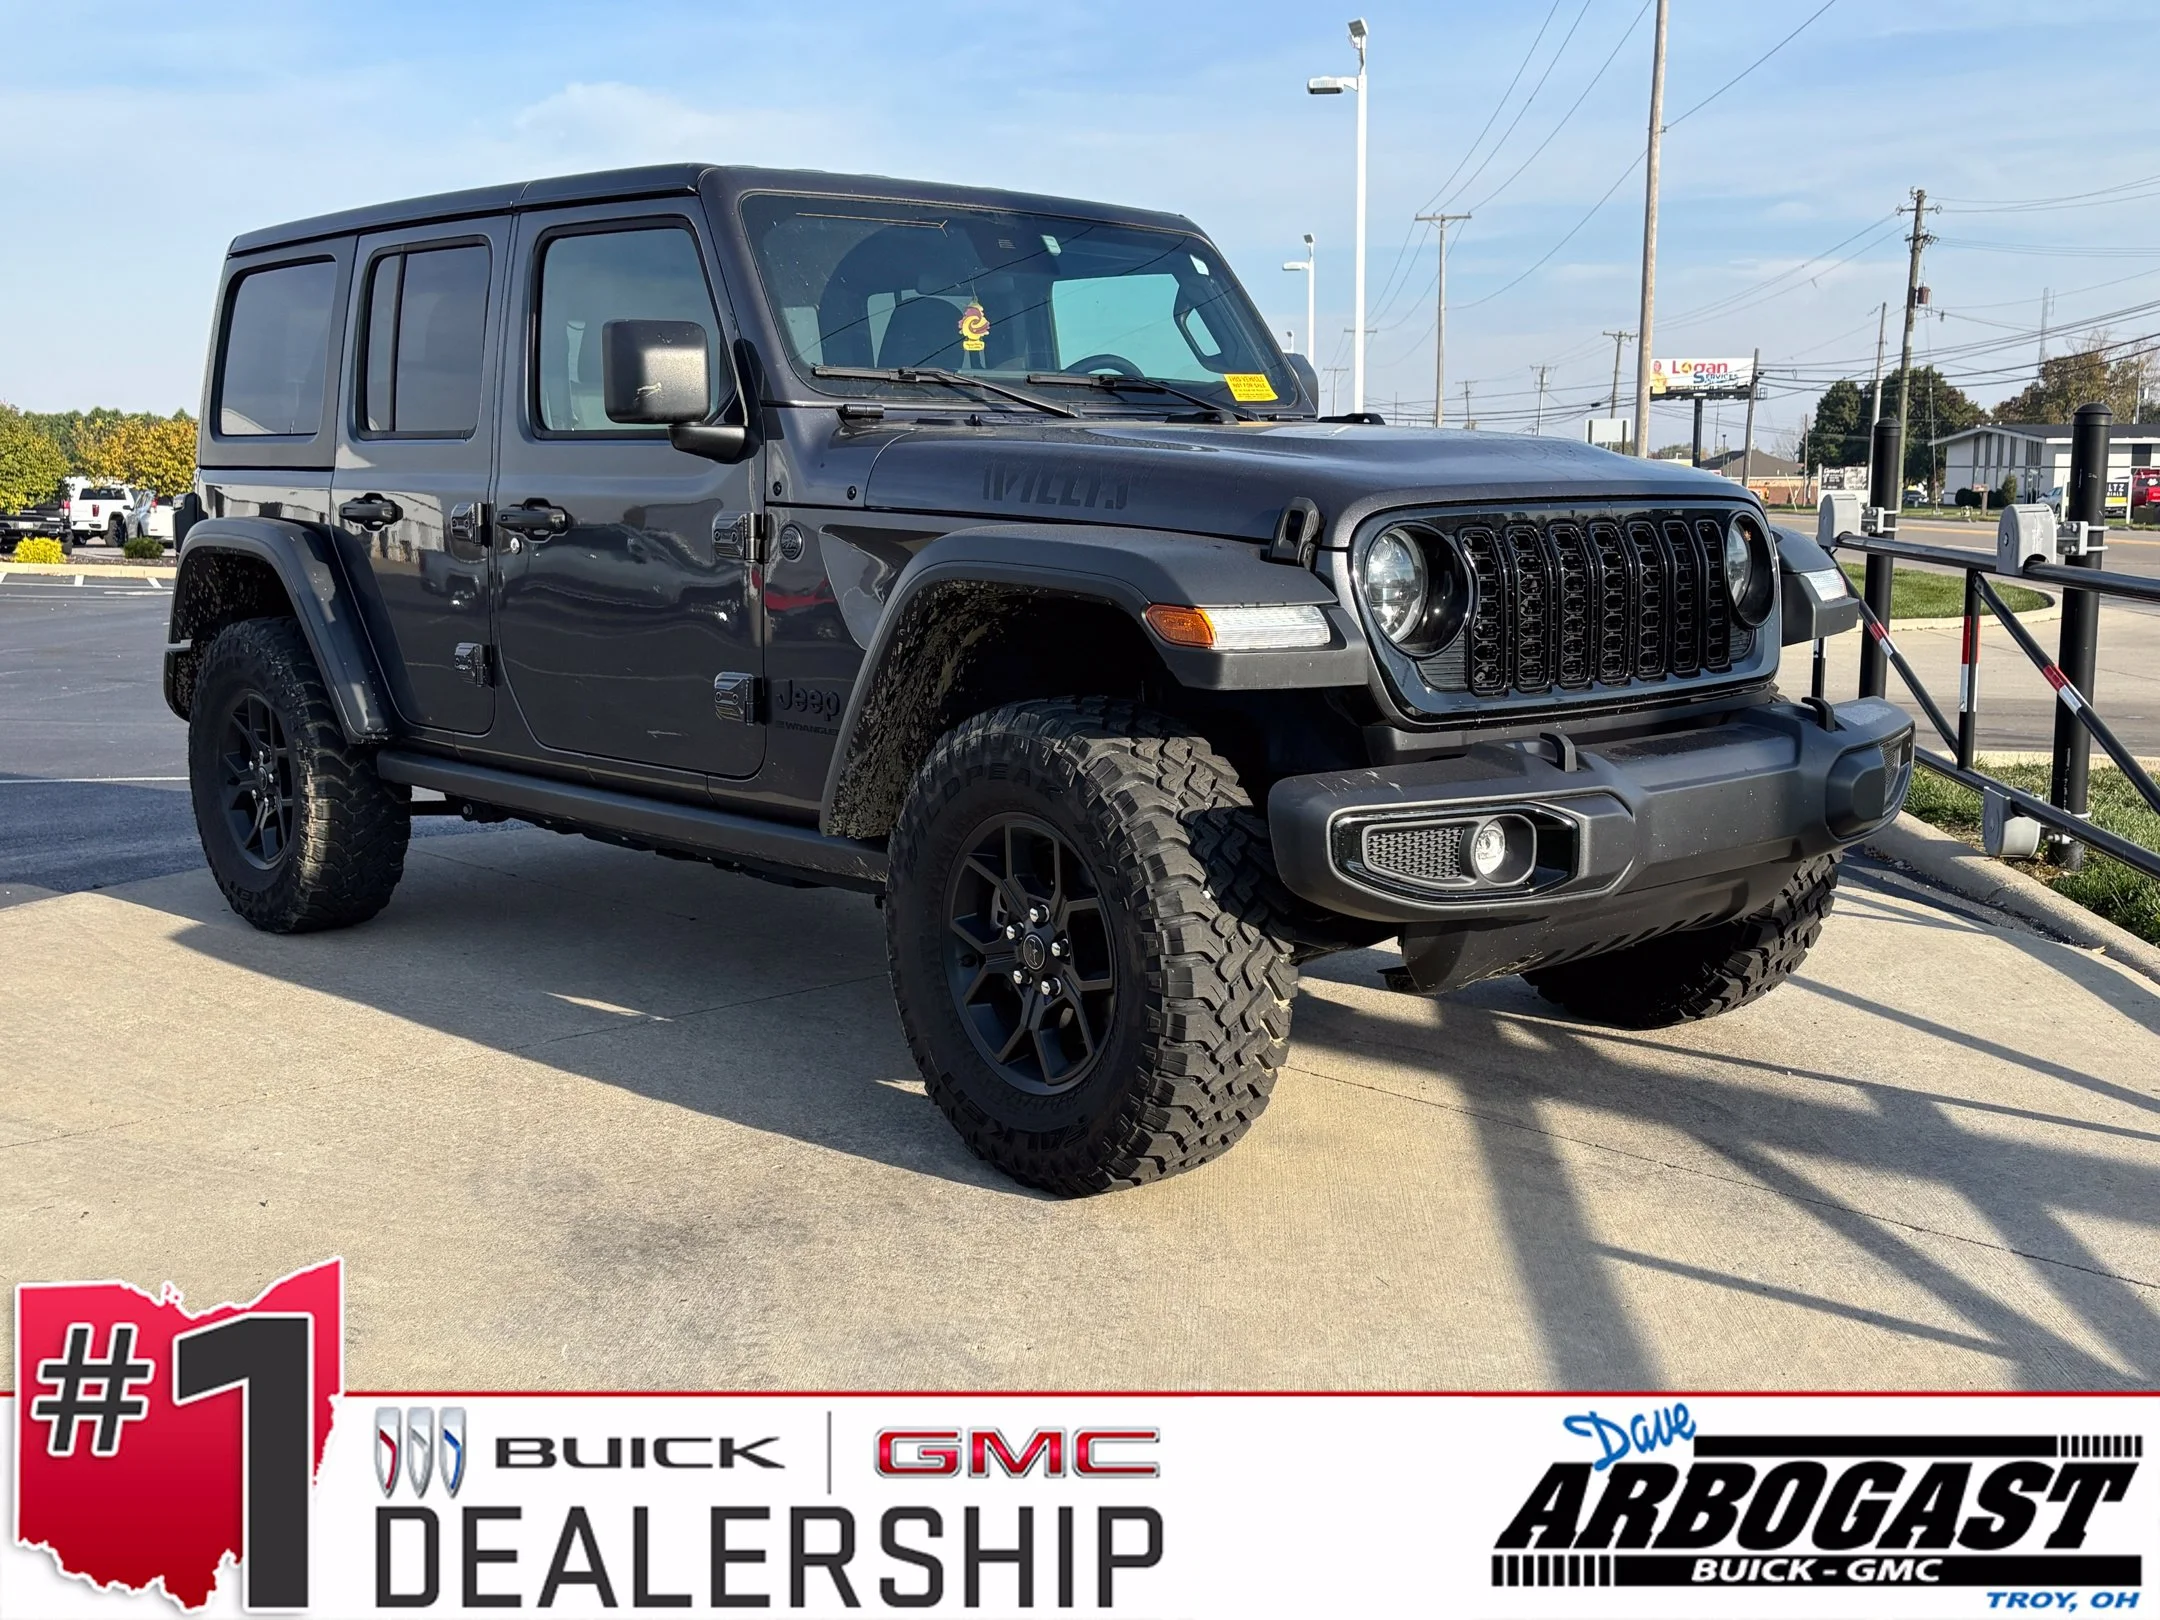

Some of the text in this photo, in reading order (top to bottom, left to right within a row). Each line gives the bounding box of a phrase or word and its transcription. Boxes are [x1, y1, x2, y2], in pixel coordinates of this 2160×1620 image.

[1671, 360, 1728, 375] Logan
[2108, 483, 2125, 492] LTZ
[776, 680, 840, 722] Jeep
